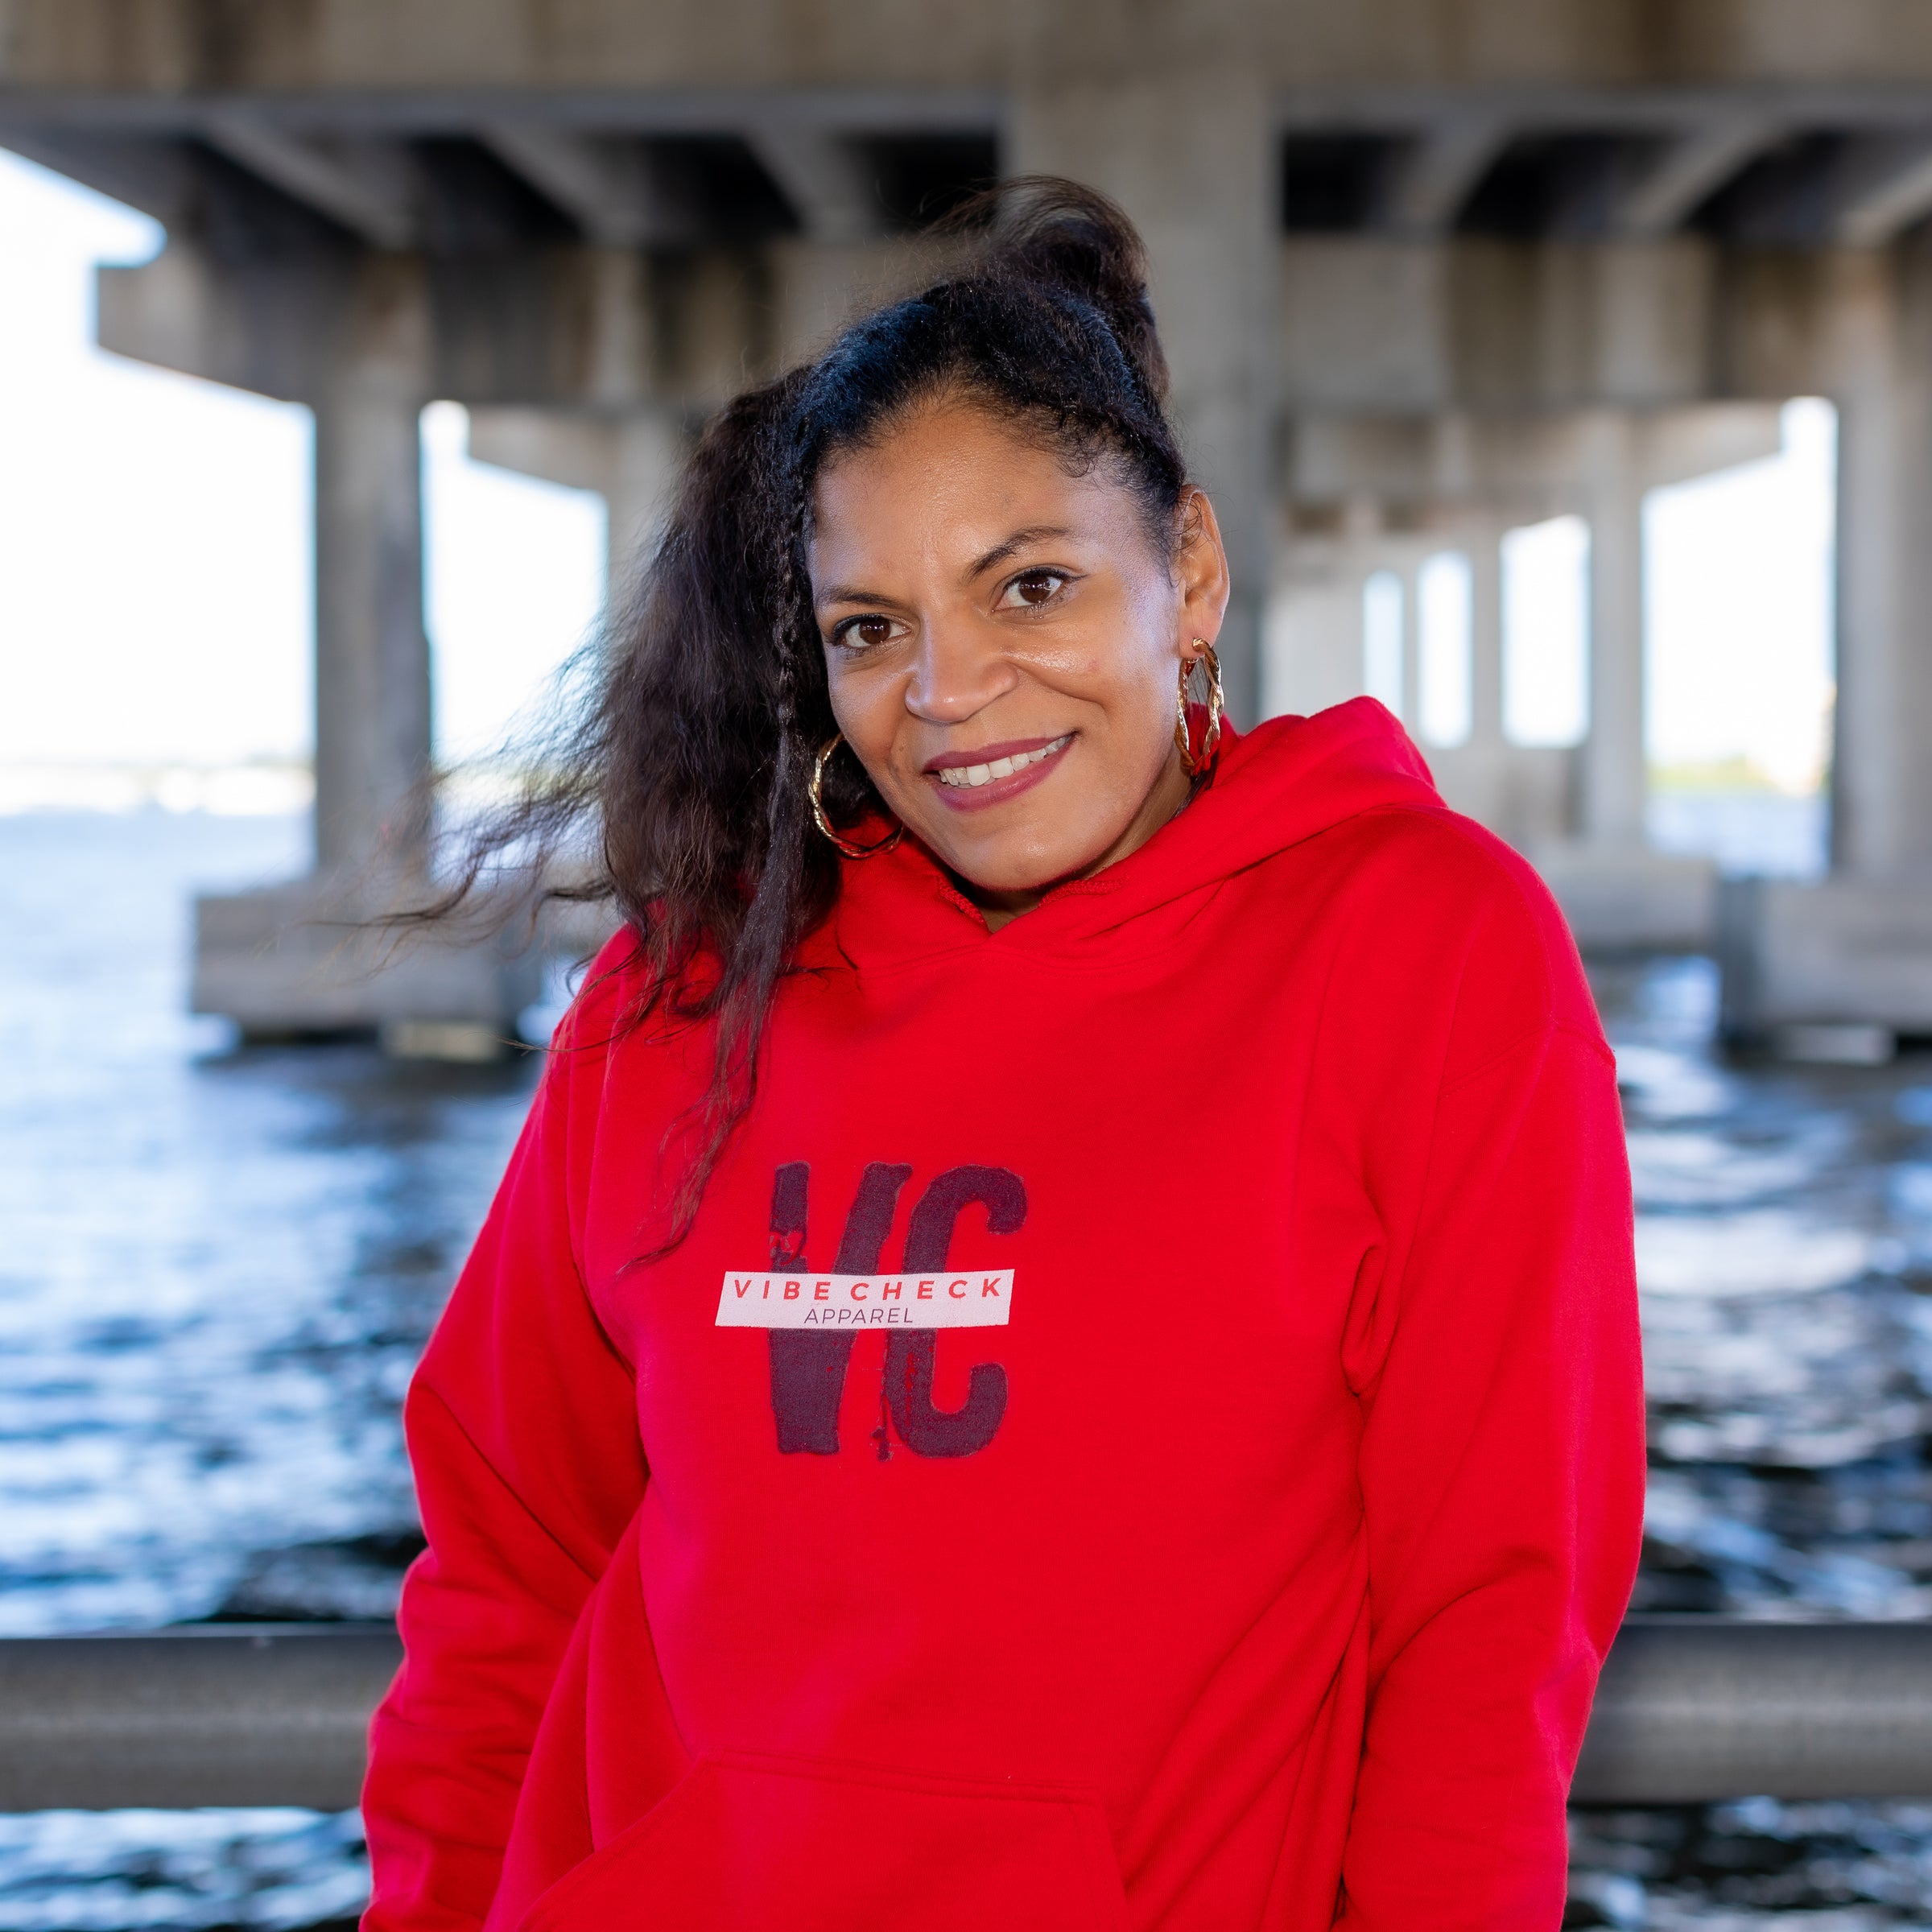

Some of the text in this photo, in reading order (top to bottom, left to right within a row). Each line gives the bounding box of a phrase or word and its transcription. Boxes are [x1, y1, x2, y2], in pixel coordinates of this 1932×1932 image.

[734, 1278, 1001, 1302] VIBE CHECK
[769, 1161, 1028, 1459] VC
[803, 1307, 914, 1325] APPAREL
